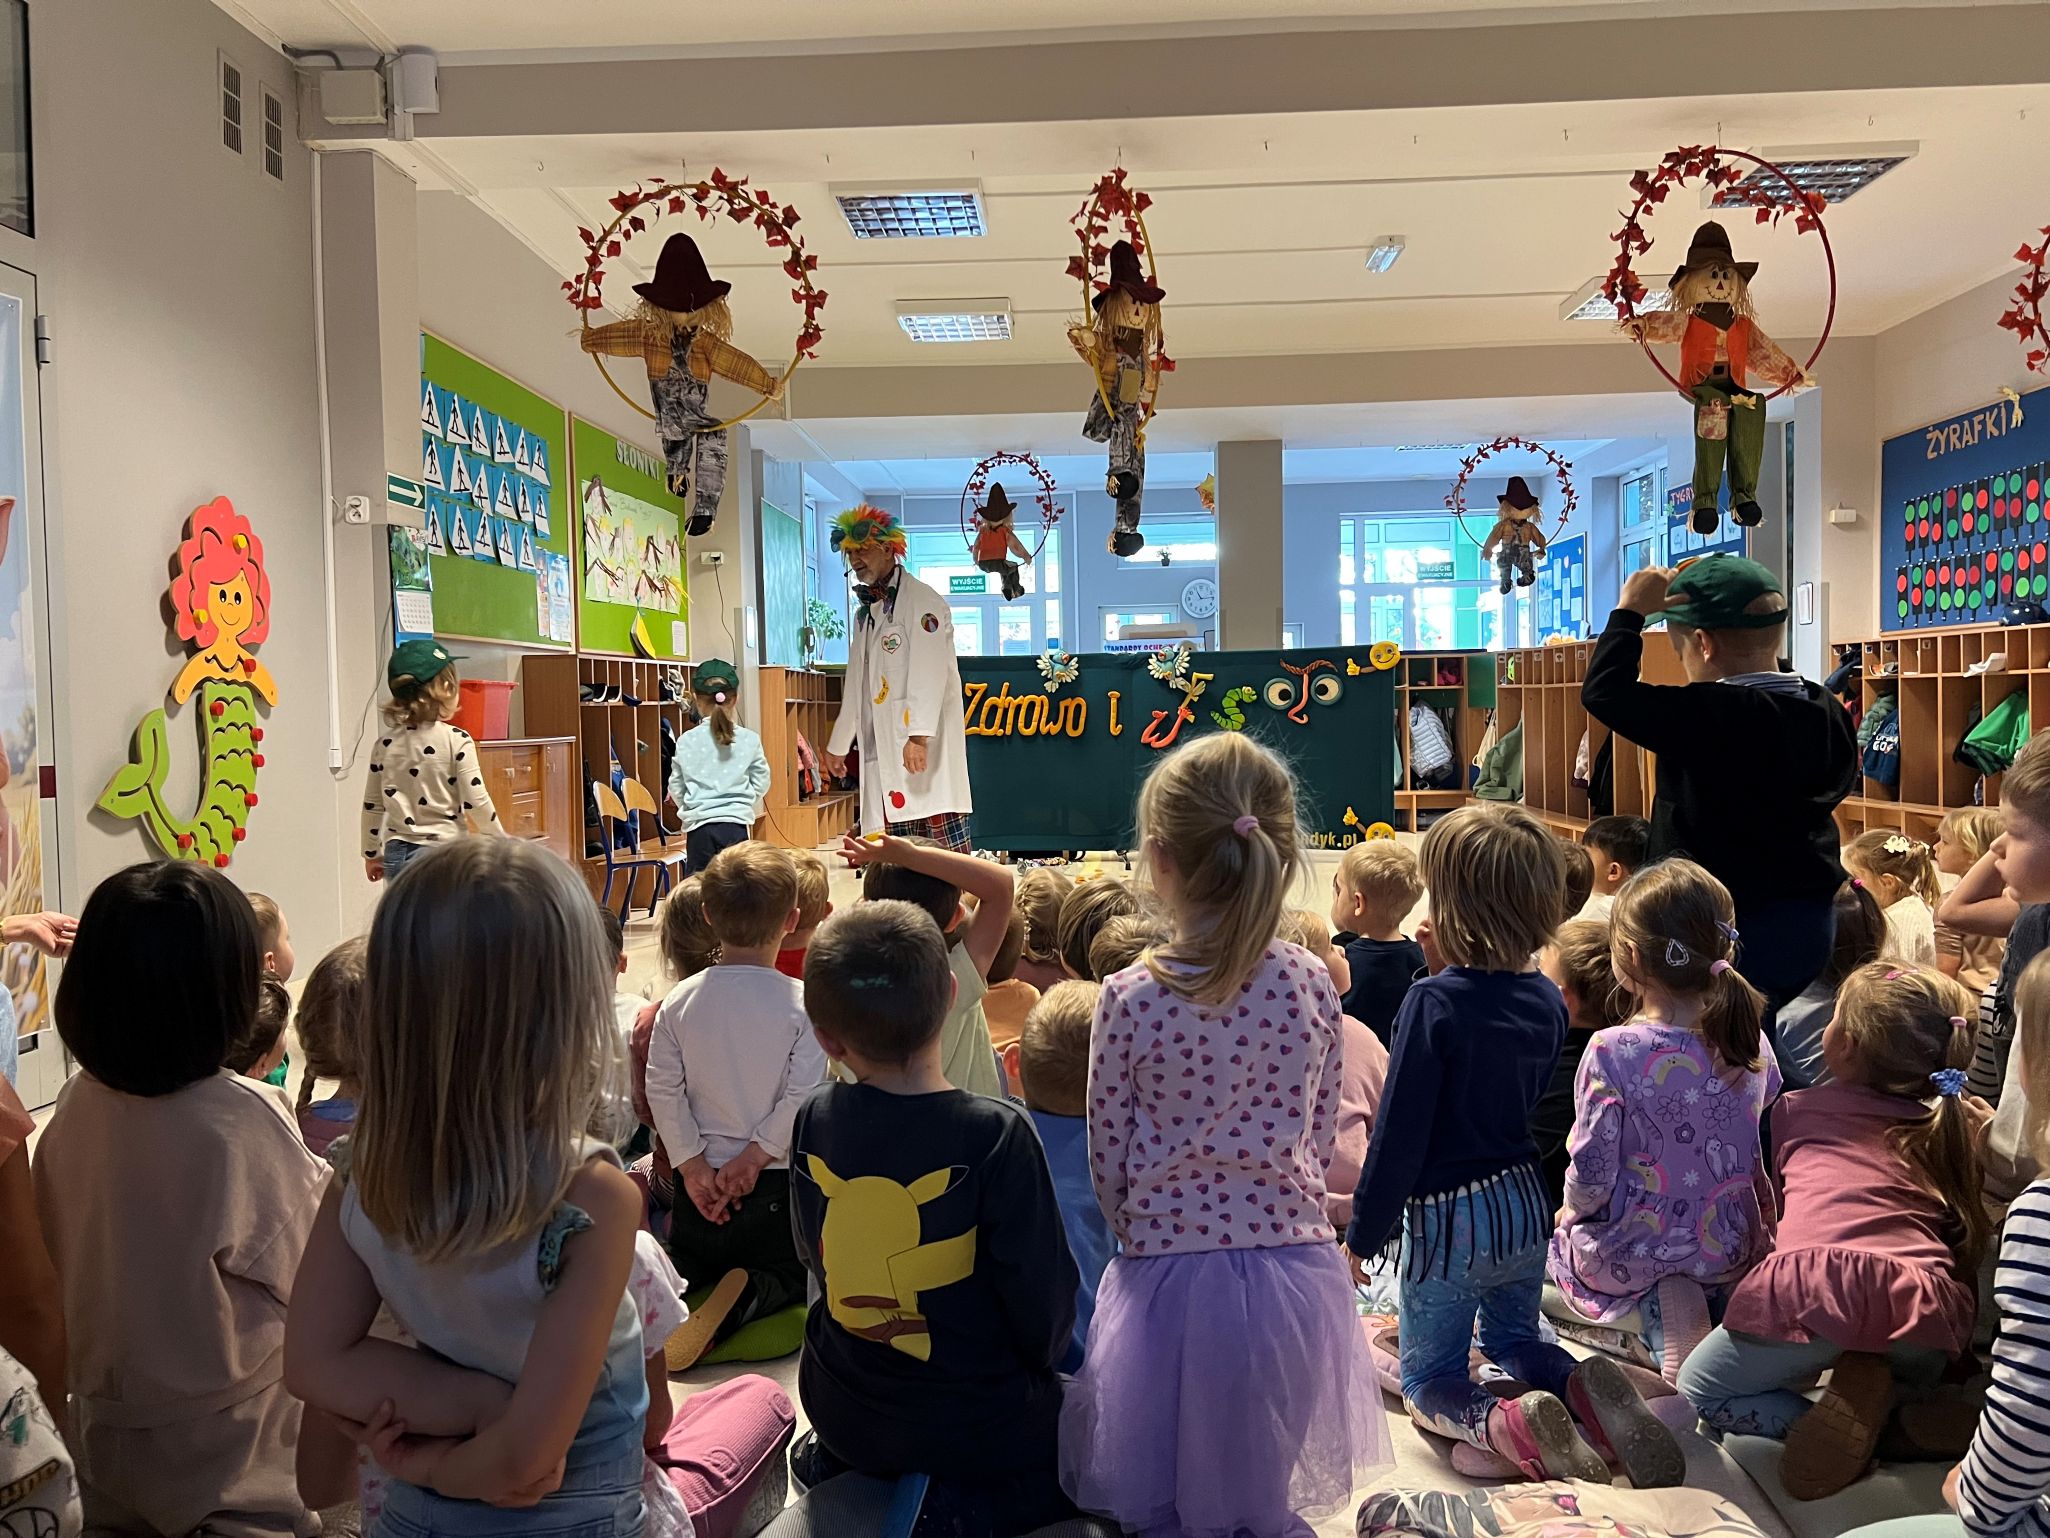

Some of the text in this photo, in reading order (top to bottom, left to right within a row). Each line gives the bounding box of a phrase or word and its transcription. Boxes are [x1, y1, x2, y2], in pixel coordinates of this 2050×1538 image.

[1926, 402, 2007, 460] ŻYRAFKI
[616, 439, 660, 480] SŁONIKI
[951, 577, 983, 585] WYJŚCIE
[964, 681, 1087, 737] Zdrowo
[1107, 691, 1123, 736] i
